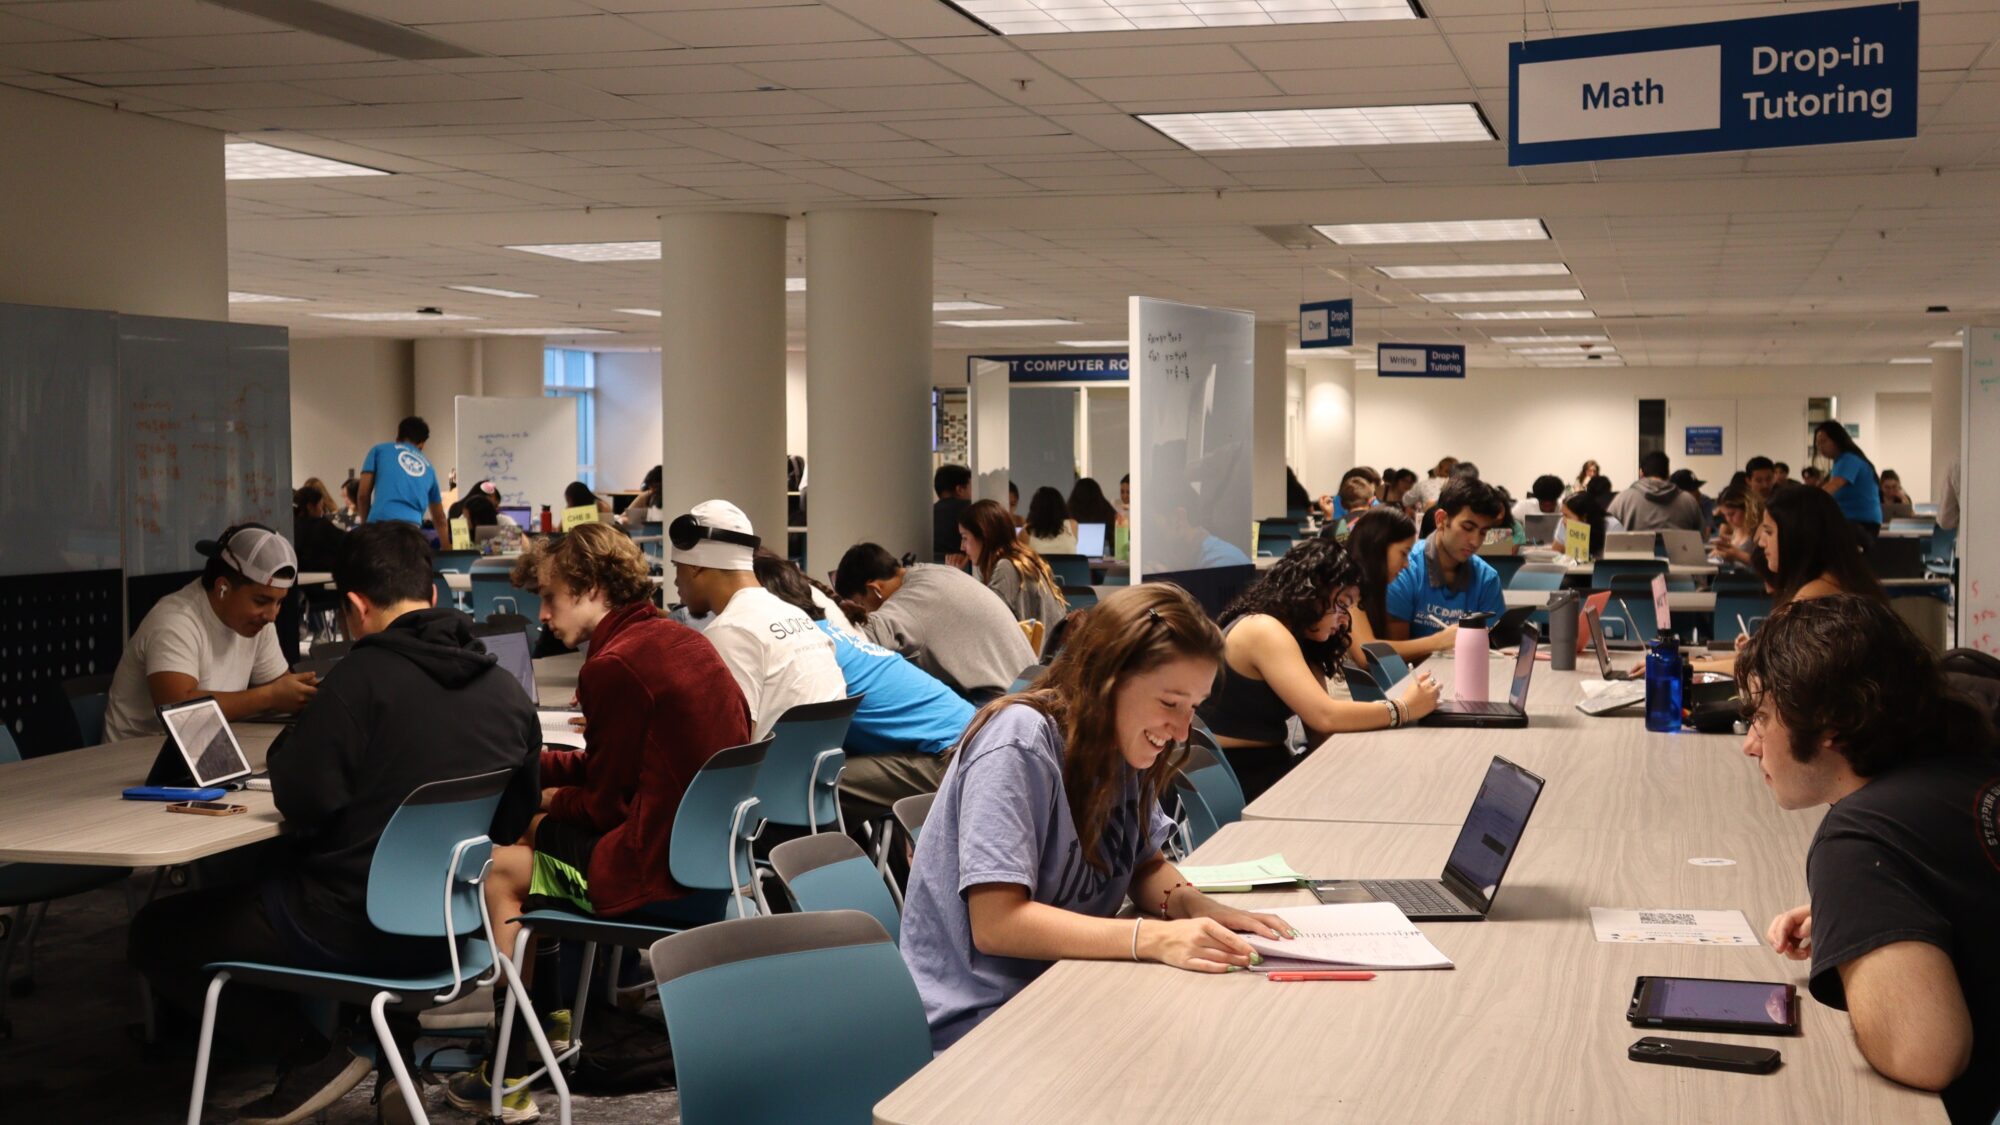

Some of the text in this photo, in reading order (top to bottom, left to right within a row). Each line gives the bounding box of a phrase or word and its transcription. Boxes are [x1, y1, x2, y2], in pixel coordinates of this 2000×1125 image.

[1751, 36, 1884, 77] Drop-in
[1581, 78, 1665, 111] Math
[1742, 83, 1893, 121] Tutoring
[1331, 310, 1349, 324] Drop-in
[1330, 325, 1351, 339] Tutoring
[1390, 355, 1417, 367] Writing
[1432, 351, 1460, 361] Drop-in
[1024, 359, 1104, 372] COMPUTER
[1109, 359, 1129, 371] RO
[1430, 362, 1461, 373] Tutoring
